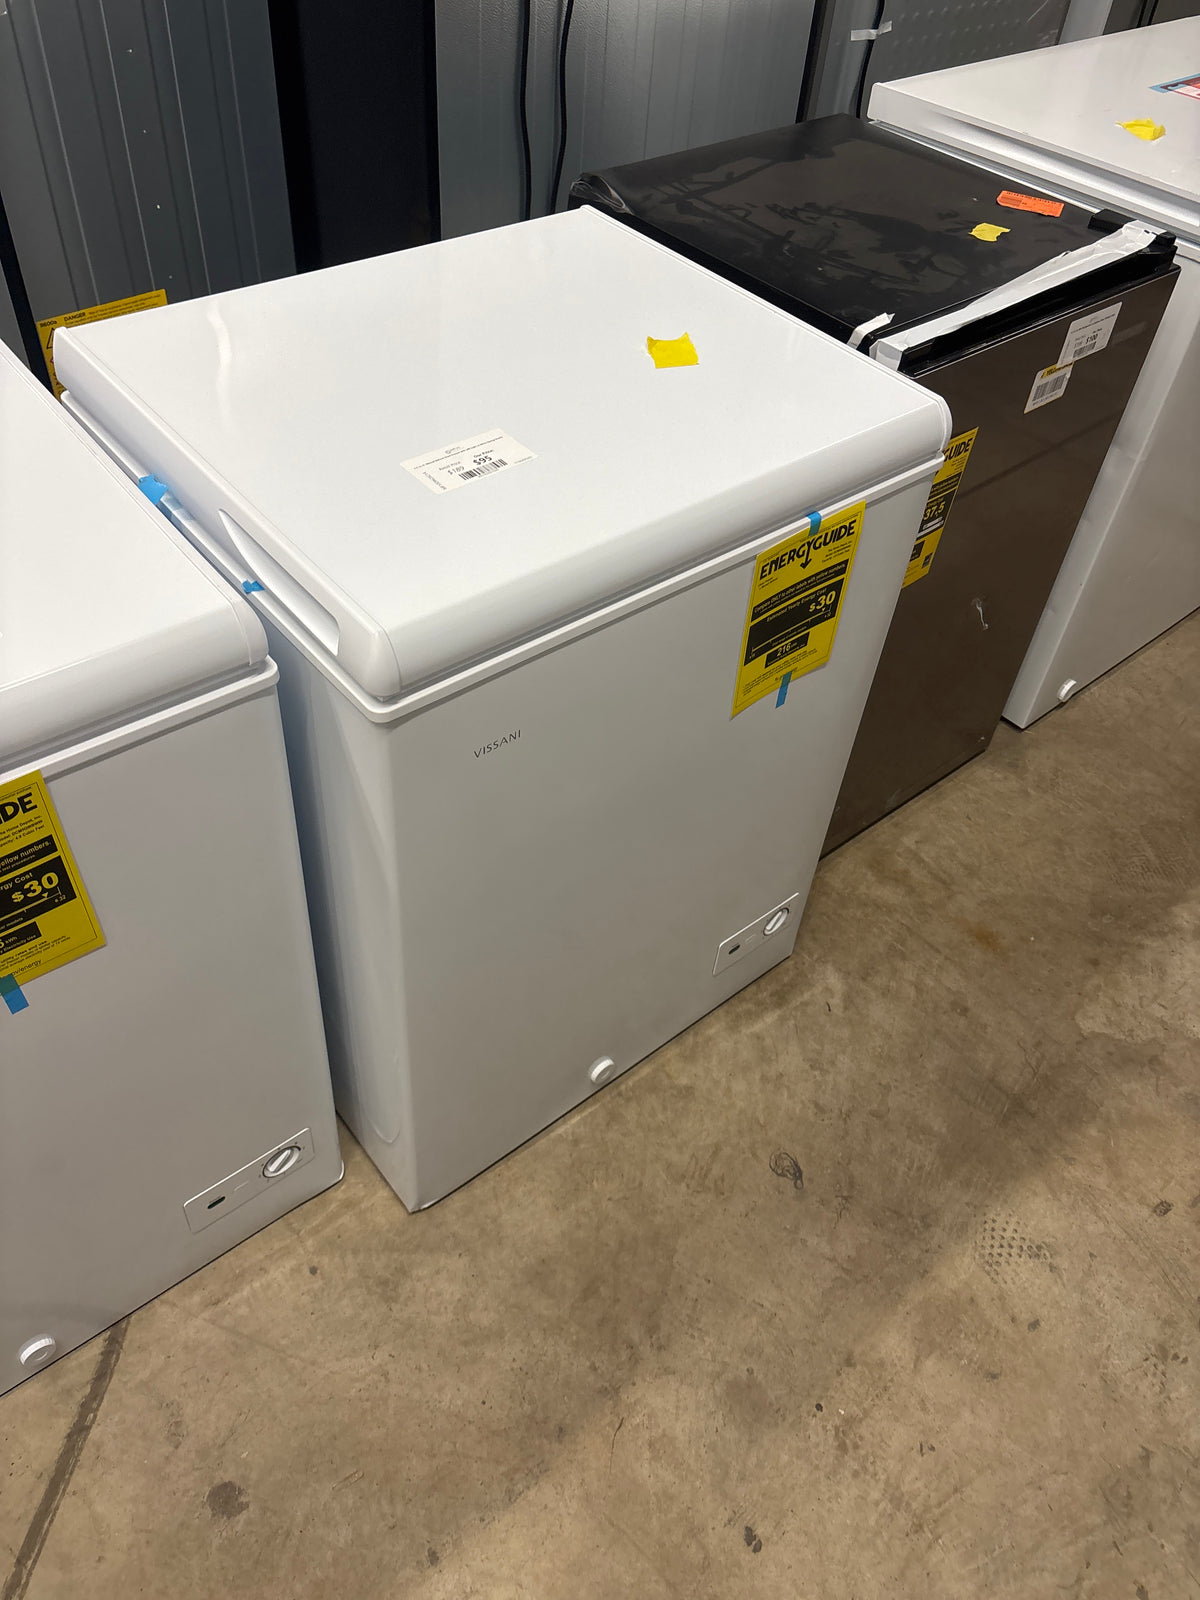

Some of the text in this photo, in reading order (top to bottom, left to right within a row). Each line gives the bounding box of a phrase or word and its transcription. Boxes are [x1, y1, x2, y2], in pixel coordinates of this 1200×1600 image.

[64, 312, 85, 321] DANGER
[472, 455, 493, 466] $95
[759, 519, 857, 580] ENERGYGUIDE
[809, 590, 836, 612] $30
[474, 729, 521, 758] VISSANI
[12, 872, 58, 902] $30
[14, 872, 33, 884] Cost
